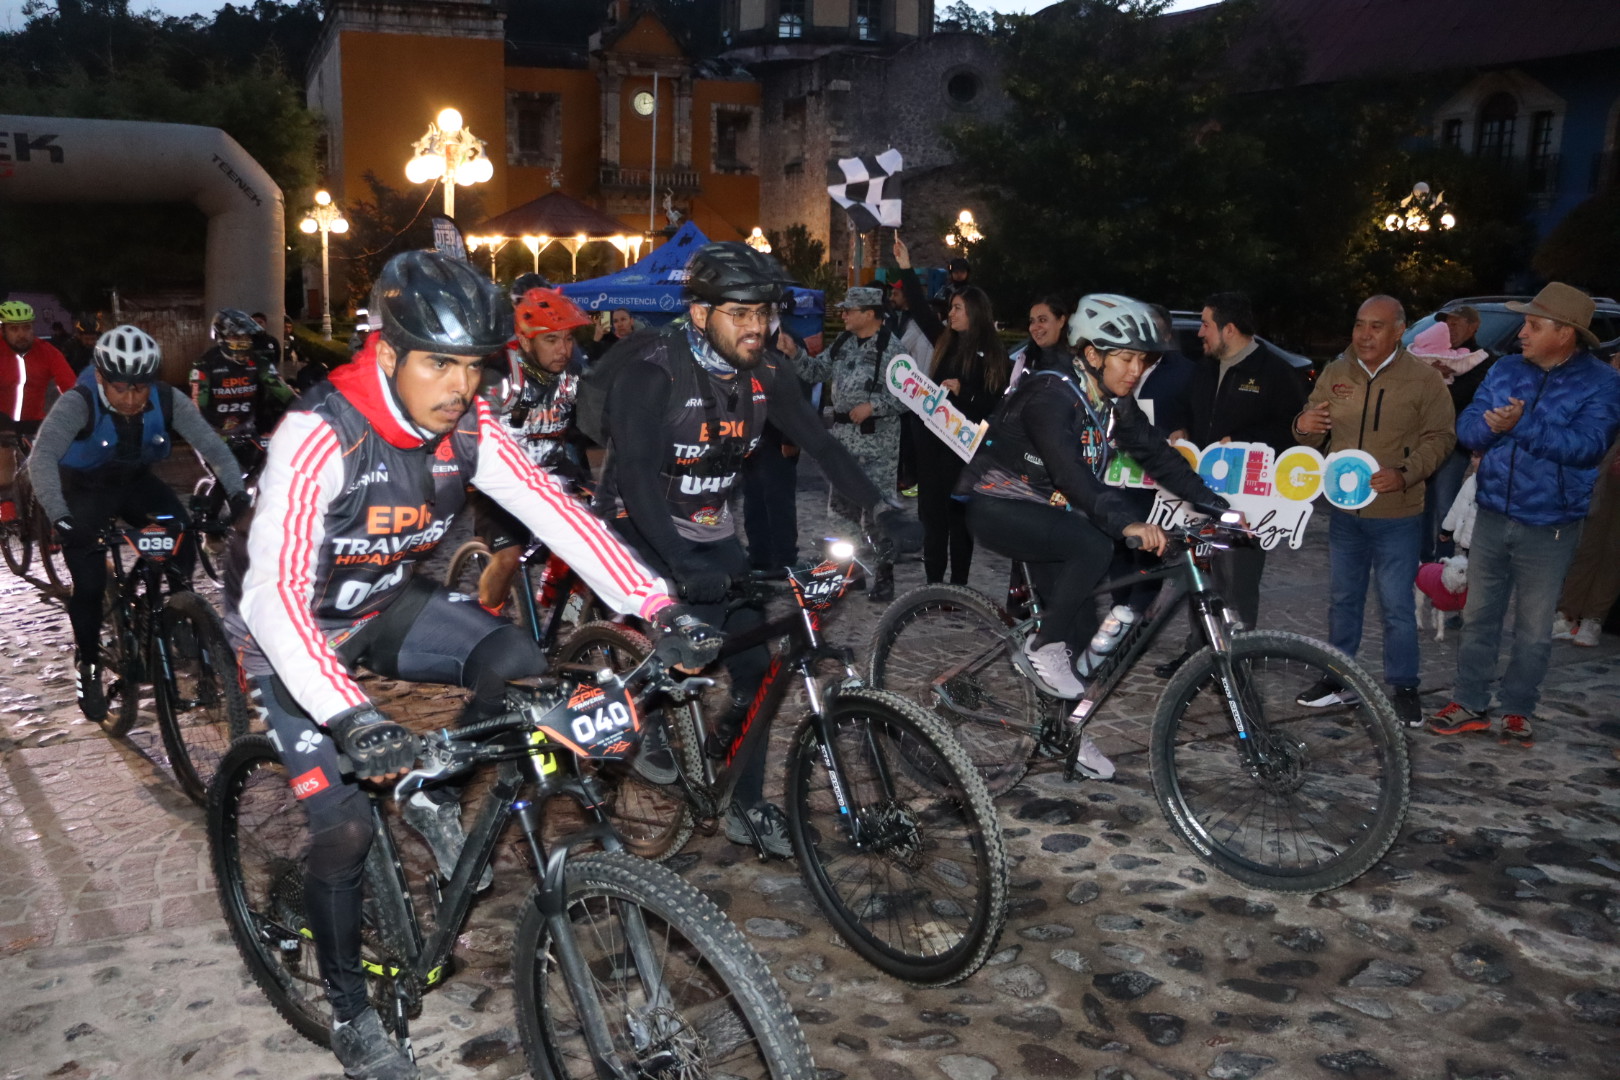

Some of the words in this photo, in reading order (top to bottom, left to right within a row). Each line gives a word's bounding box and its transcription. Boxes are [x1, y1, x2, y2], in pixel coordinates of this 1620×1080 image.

[212, 152, 262, 206] TEENEK
[608, 296, 657, 306] RESISTENCIA
[138, 537, 174, 550] 038
[332, 513, 455, 555] TRAVERSE
[336, 551, 408, 566] HIDALG
[566, 687, 607, 709] EPIC
[572, 694, 606, 711] TRAVERSE
[571, 701, 630, 744] 040
[293, 777, 320, 797] ates
